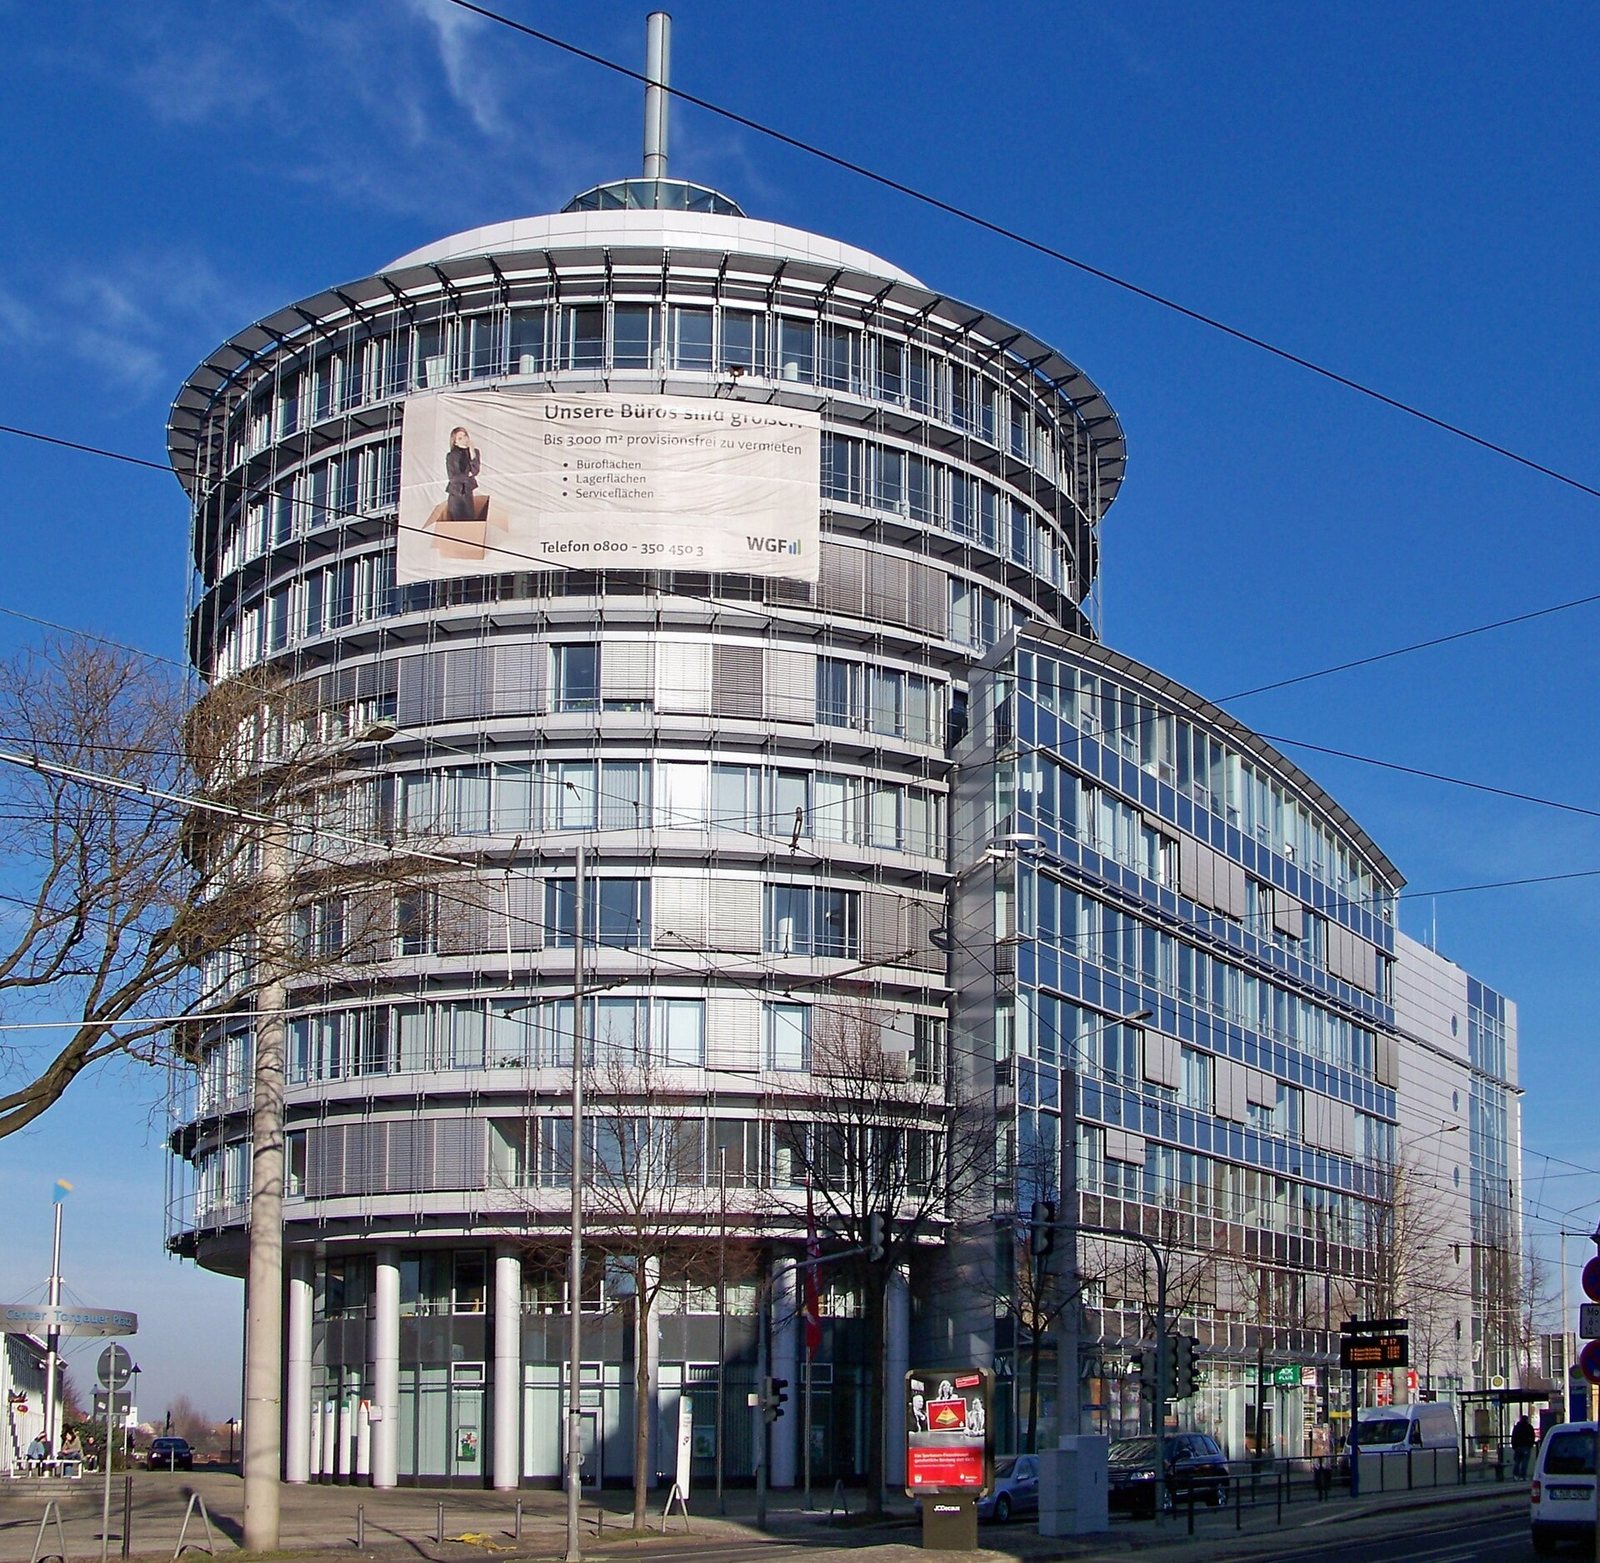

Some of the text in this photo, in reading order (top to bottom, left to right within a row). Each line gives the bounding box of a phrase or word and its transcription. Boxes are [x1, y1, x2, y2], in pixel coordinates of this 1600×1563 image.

[545, 404, 614, 419] Unsere
[621, 403, 677, 419] Büros
[544, 433, 563, 445] Bis
[606, 434, 623, 444] m²
[627, 433, 716, 447] provisionsfrei
[720, 439, 735, 449] zu
[738, 440, 802, 455] vermieten
[576, 458, 641, 469] Büroflächen
[576, 473, 646, 486] Lagerflächen
[575, 487, 654, 499] Serviceflächen
[540, 540, 590, 554] Telefon
[593, 540, 628, 553] 0800
[641, 543, 664, 555] 350
[669, 544, 693, 556] 450
[696, 546, 704, 557] 3
[746, 535, 787, 554] WGF
[6, 1309, 133, 1327] Center Torgauer Platz
